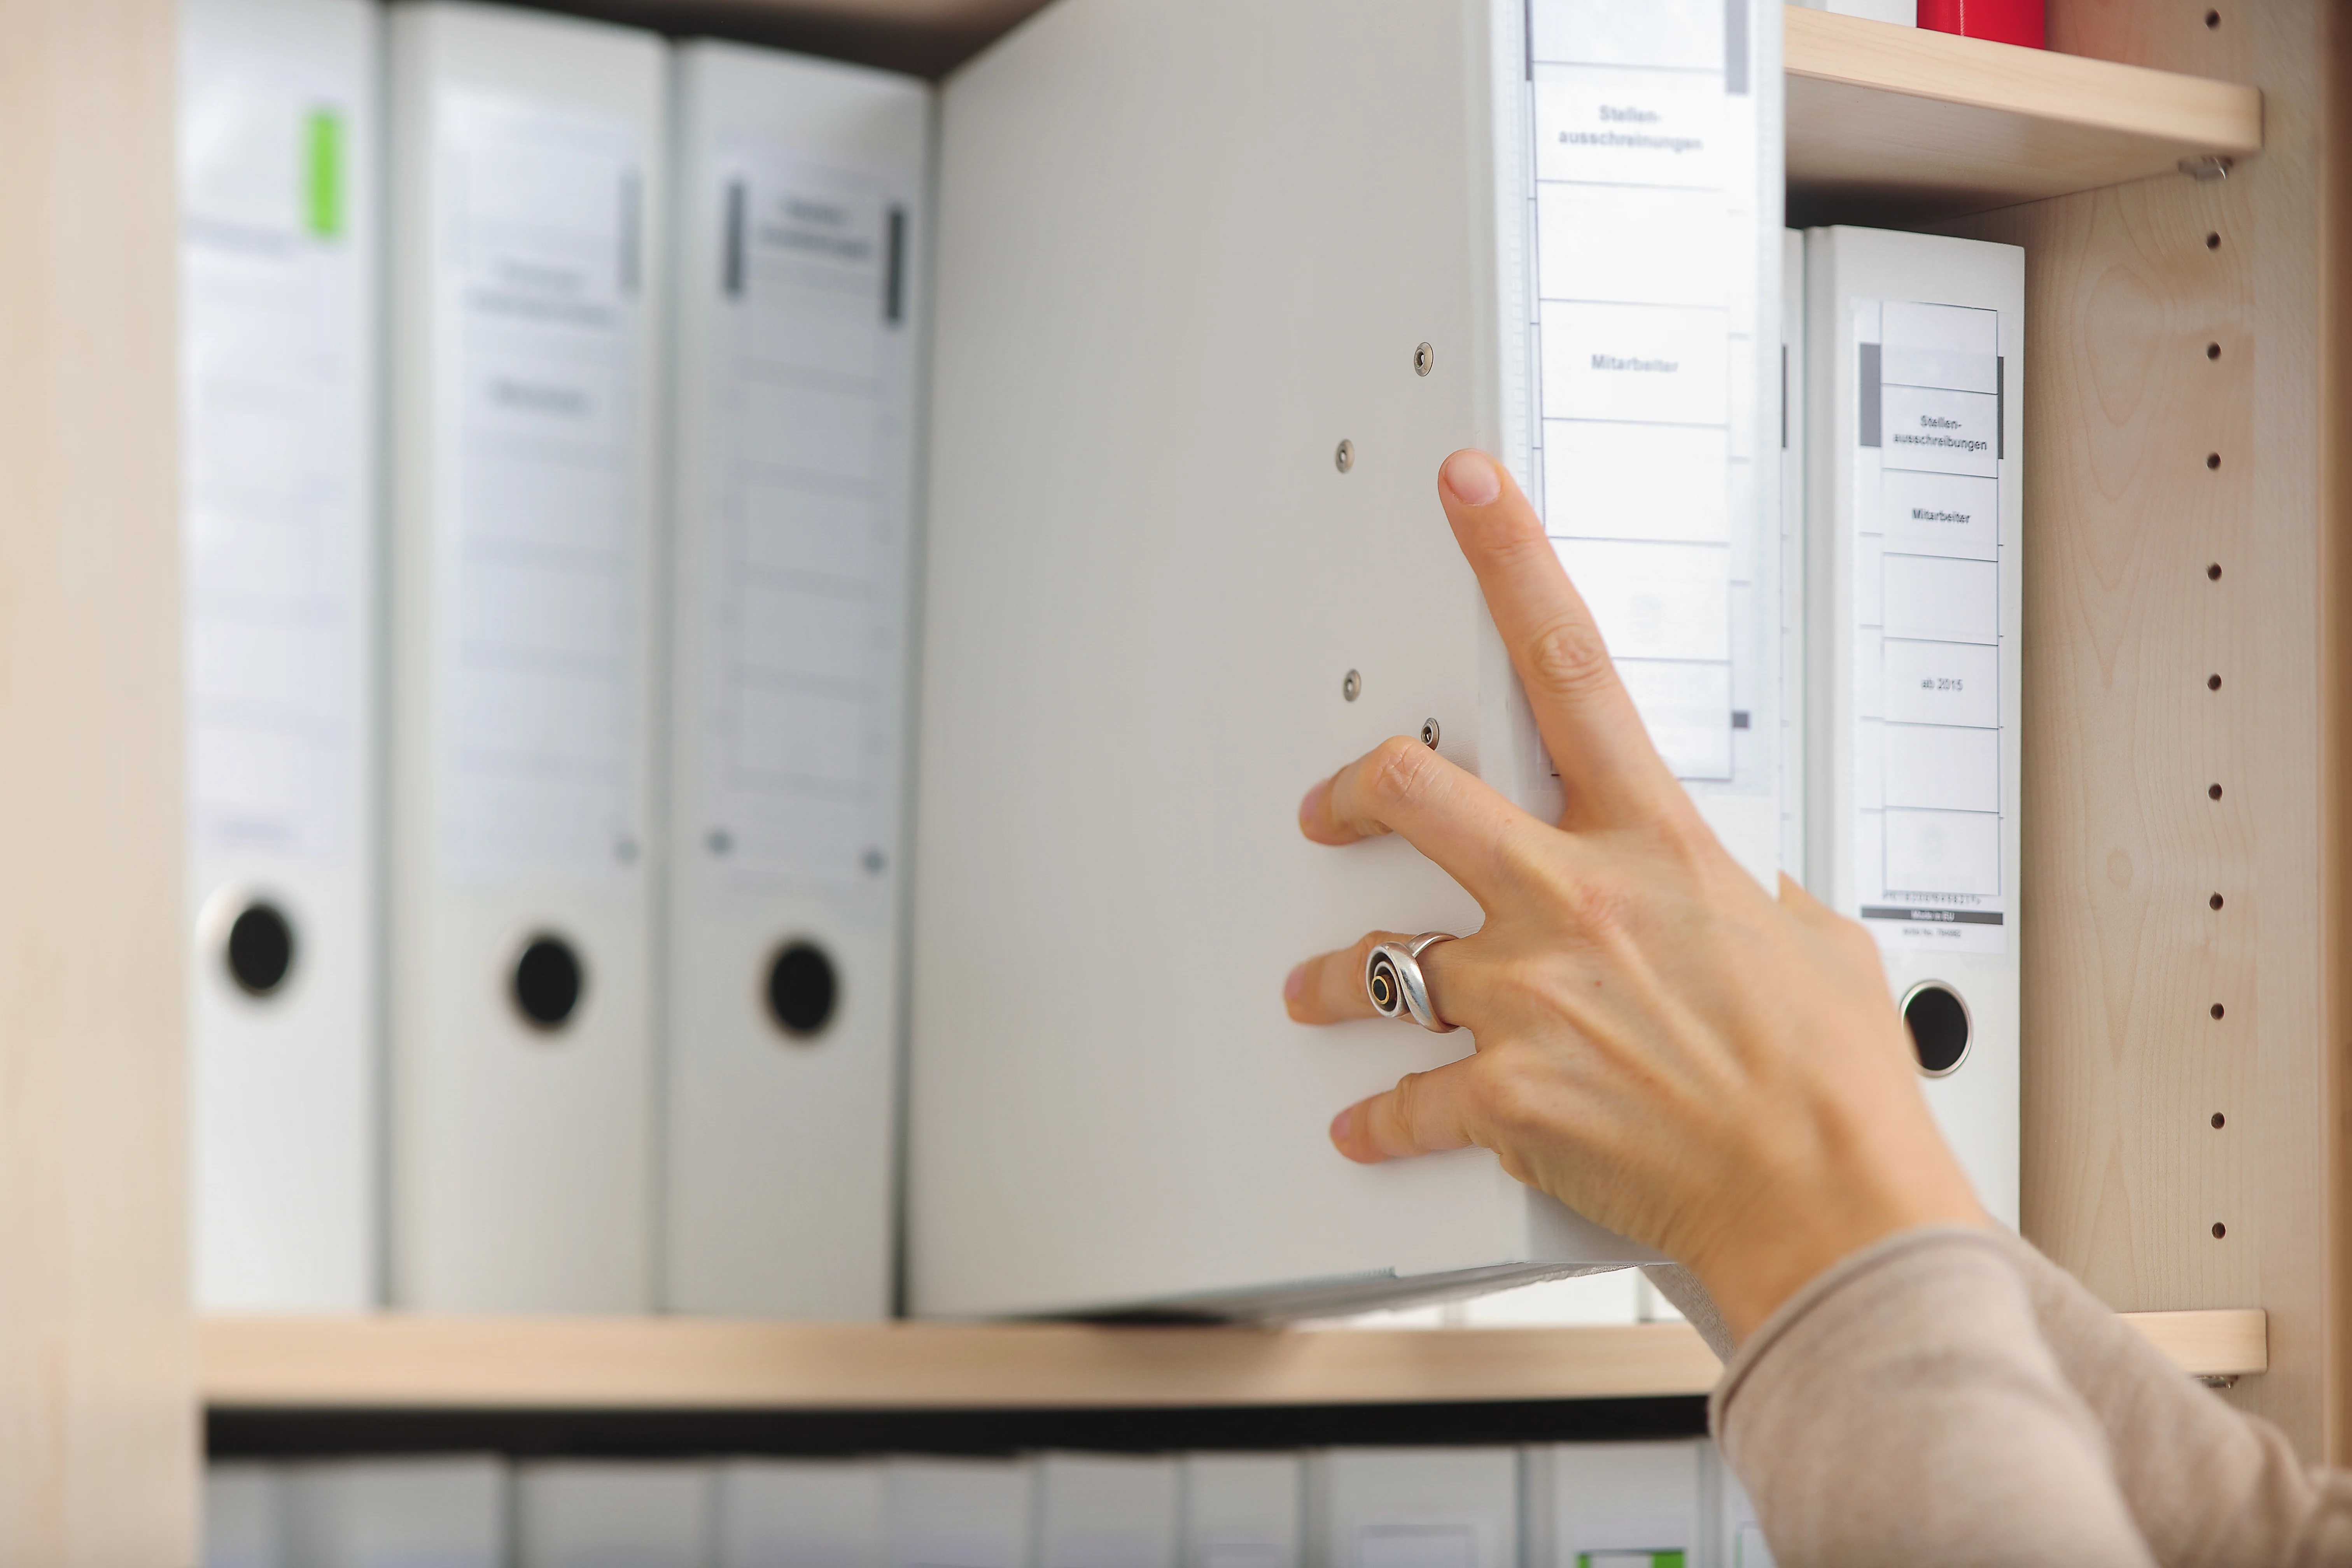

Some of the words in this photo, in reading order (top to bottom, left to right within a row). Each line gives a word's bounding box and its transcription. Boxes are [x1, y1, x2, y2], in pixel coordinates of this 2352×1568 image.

[1599, 104, 1662, 123] Stellen-
[1591, 354, 1679, 373] Mitarbeiter
[1920, 415, 1962, 429] Stellen-
[1893, 434, 1988, 451] ausschreibungen
[1912, 508, 1970, 523] Mitarbeiter
[1921, 677, 1935, 690] ab
[1937, 678, 1963, 691] 2015
